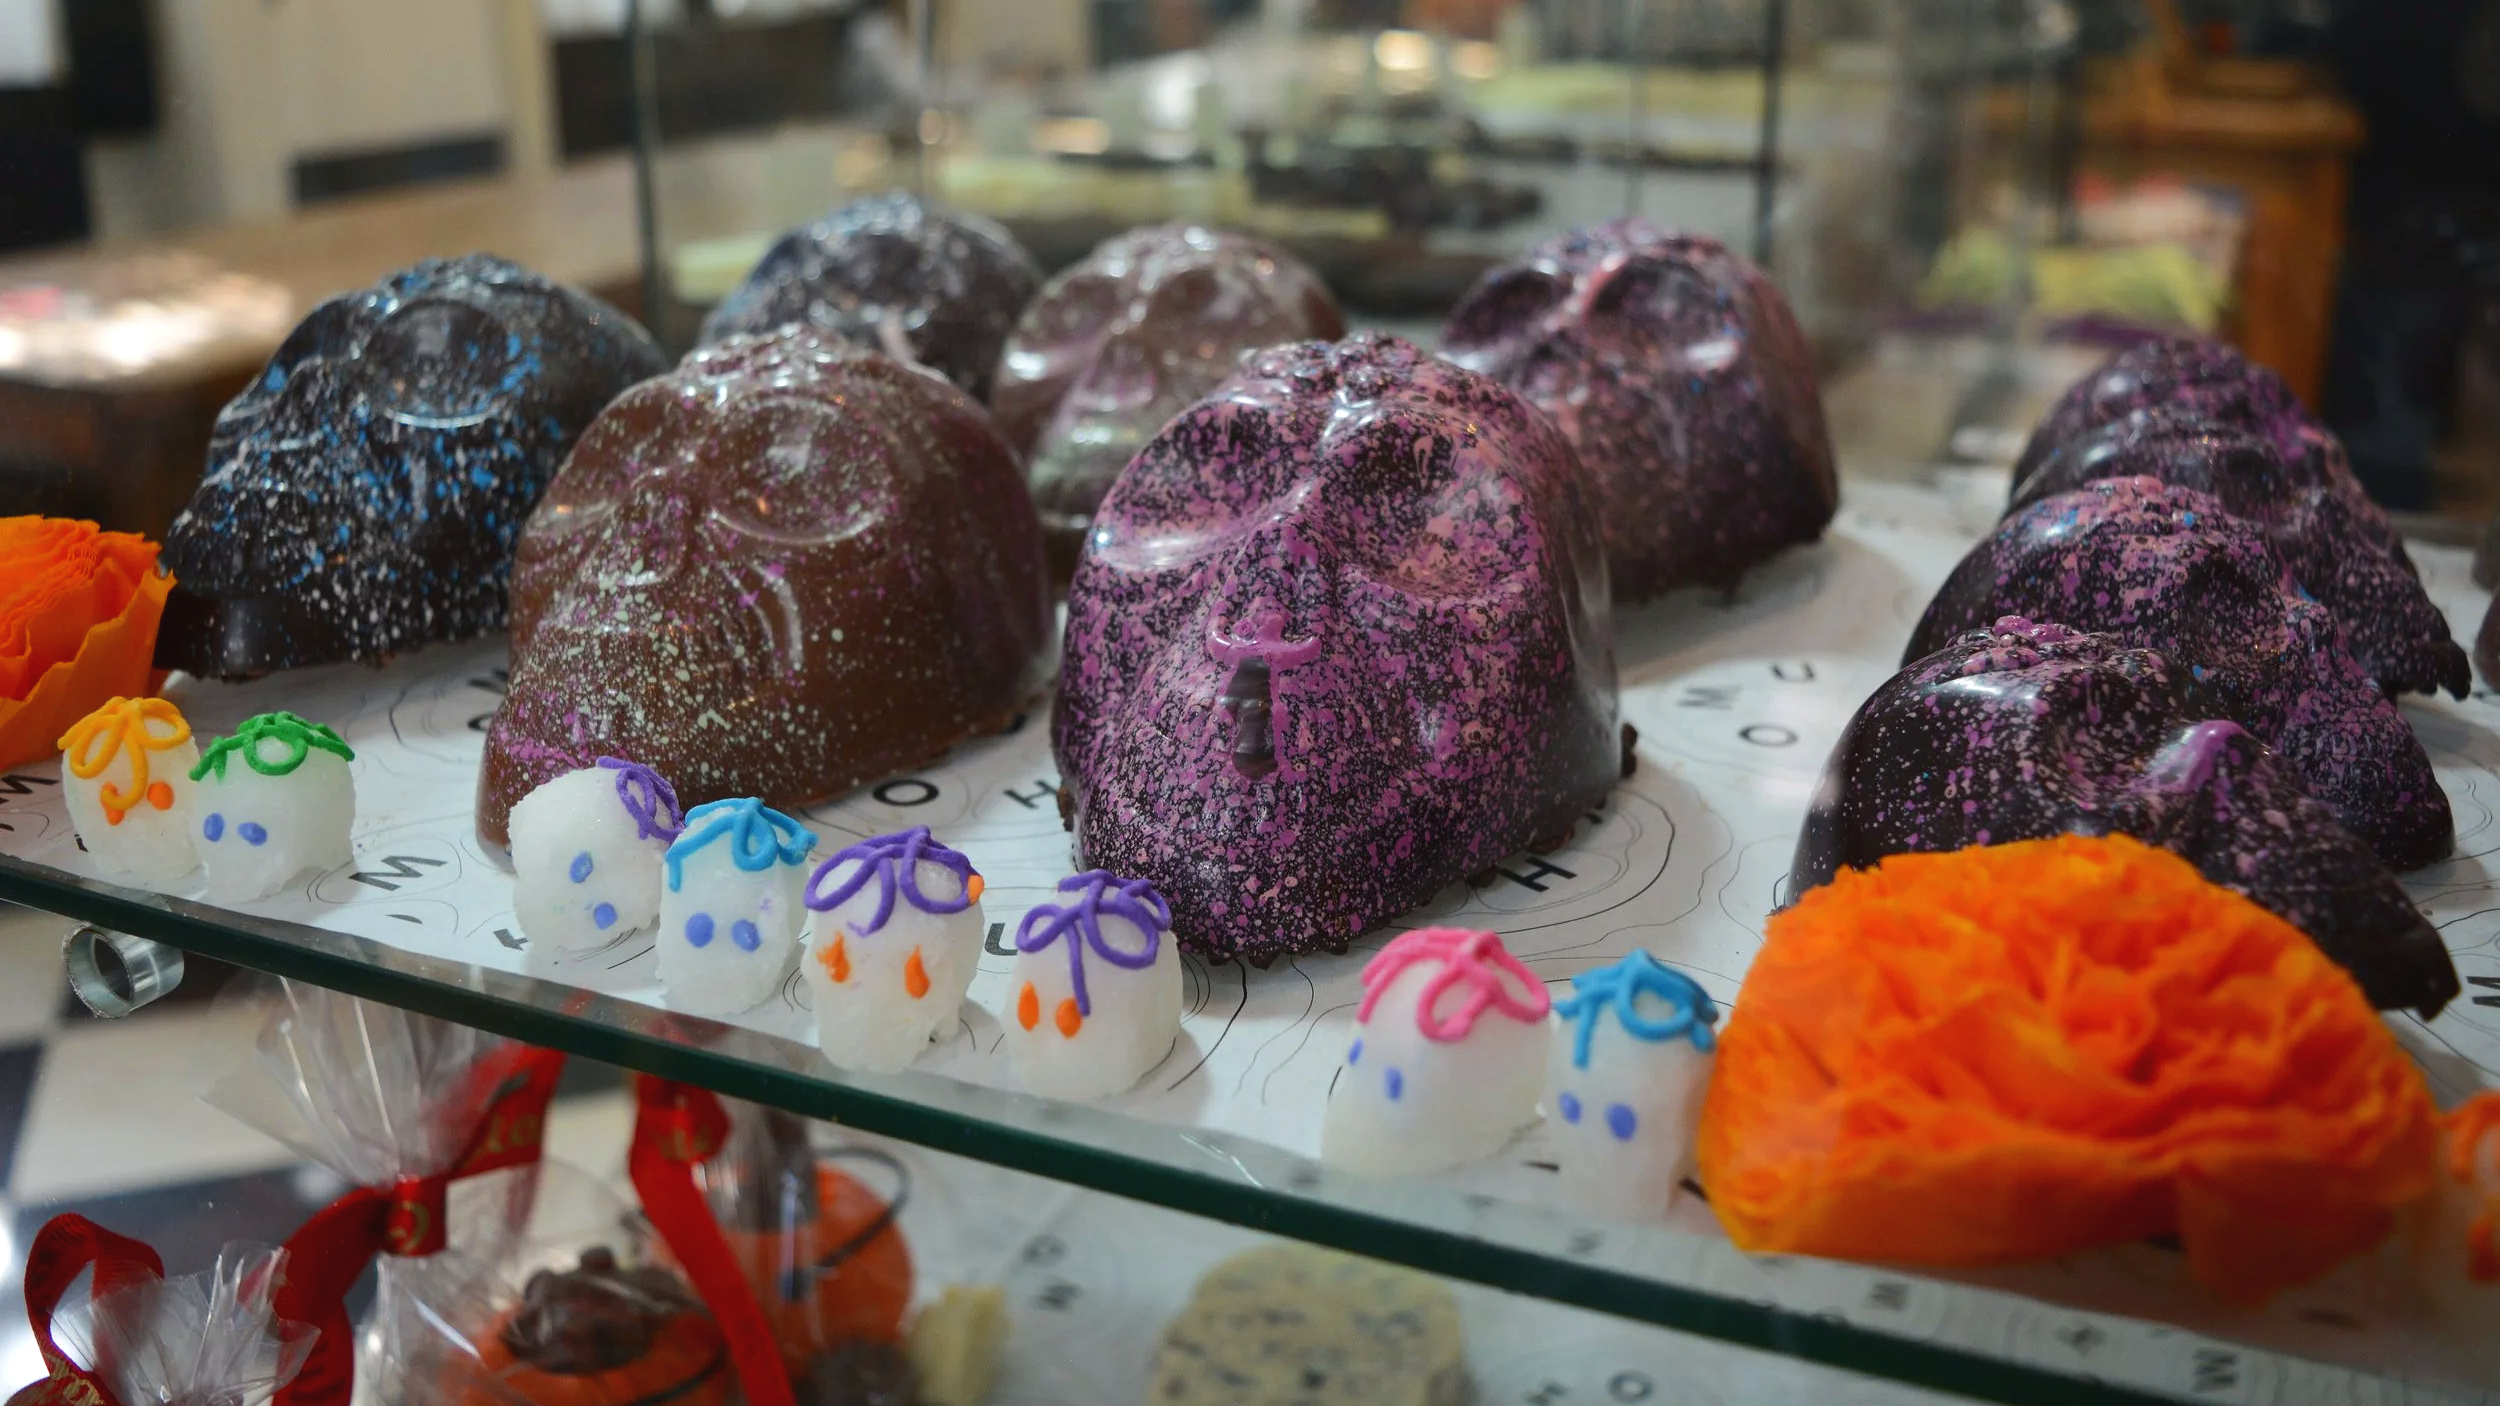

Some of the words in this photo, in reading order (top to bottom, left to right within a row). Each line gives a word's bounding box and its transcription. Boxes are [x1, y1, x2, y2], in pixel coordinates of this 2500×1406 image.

[1737, 725, 1798, 748] O
[872, 779, 939, 807] O
[1003, 780, 1057, 809] H
[348, 855, 449, 892] M
[1495, 857, 1578, 893] H
